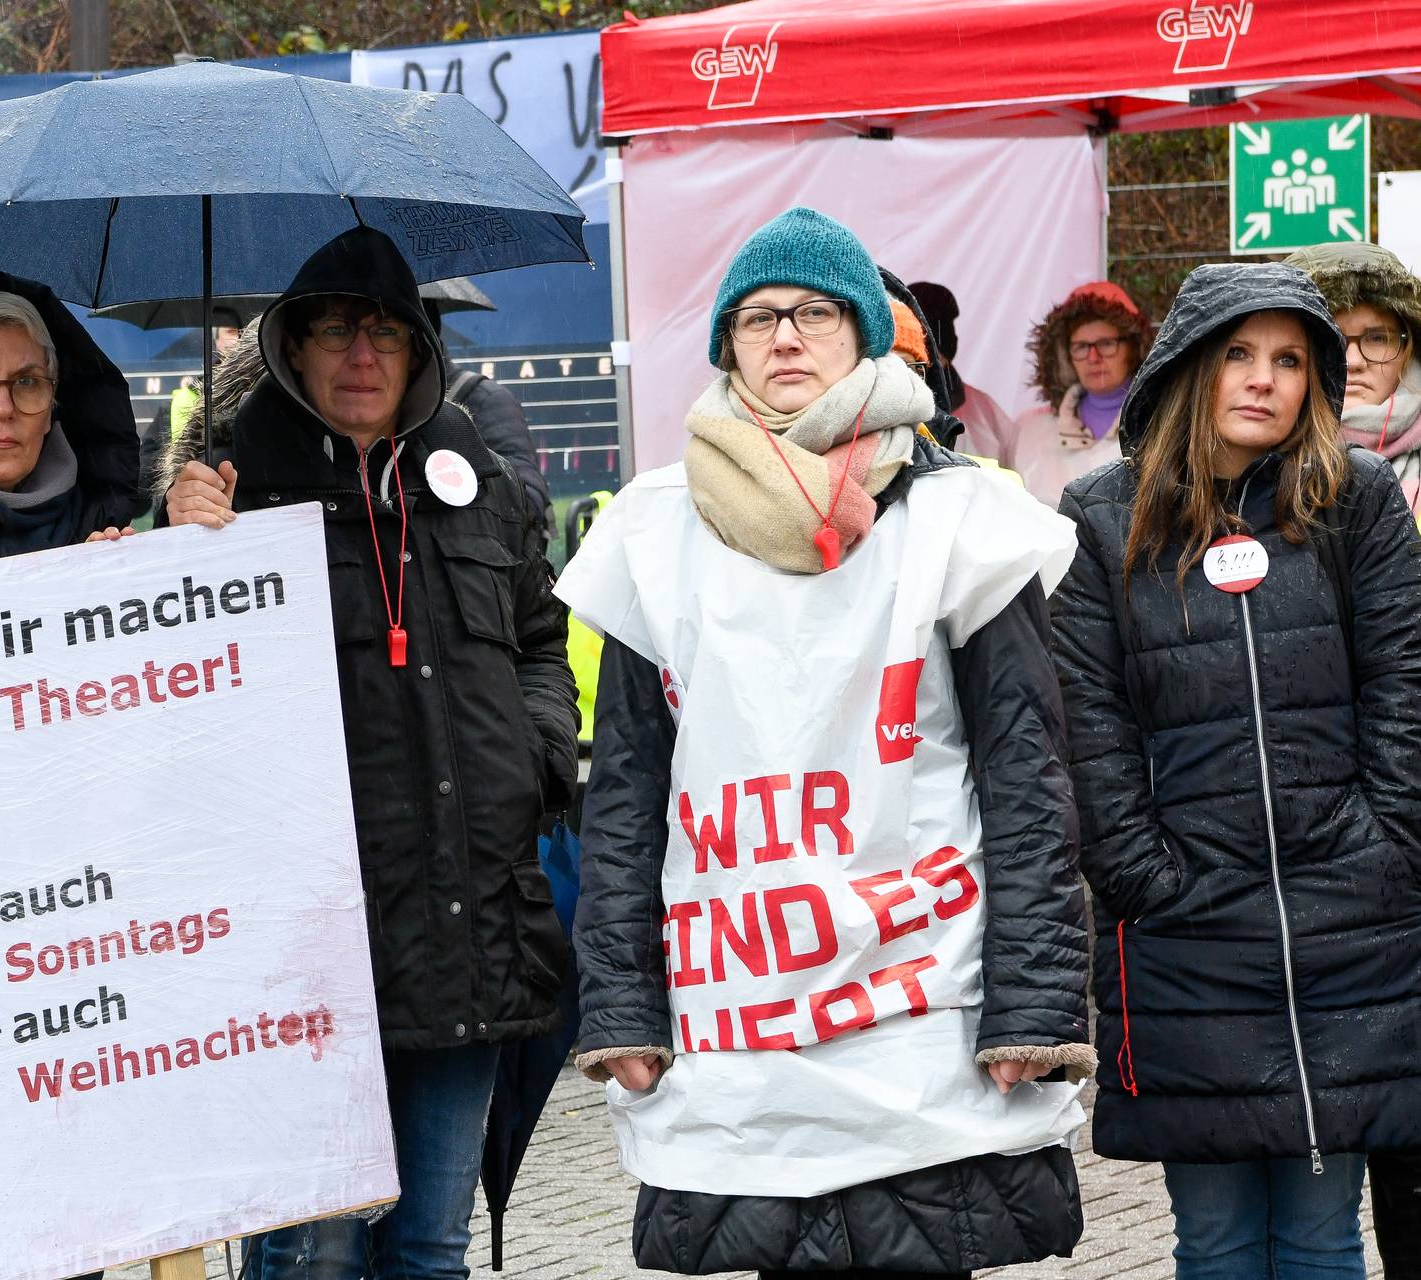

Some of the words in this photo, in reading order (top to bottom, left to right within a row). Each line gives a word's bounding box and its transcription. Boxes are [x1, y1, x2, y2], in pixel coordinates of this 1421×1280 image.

[691, 22, 781, 80] GEW
[1157, 0, 1253, 48] GEW
[64, 571, 285, 646] machen
[0, 643, 243, 731] Theater!
[679, 770, 854, 874] WIR
[849, 845, 980, 946] ES
[5, 906, 232, 984] Sonntags
[18, 1006, 334, 1103] Weihnachten
